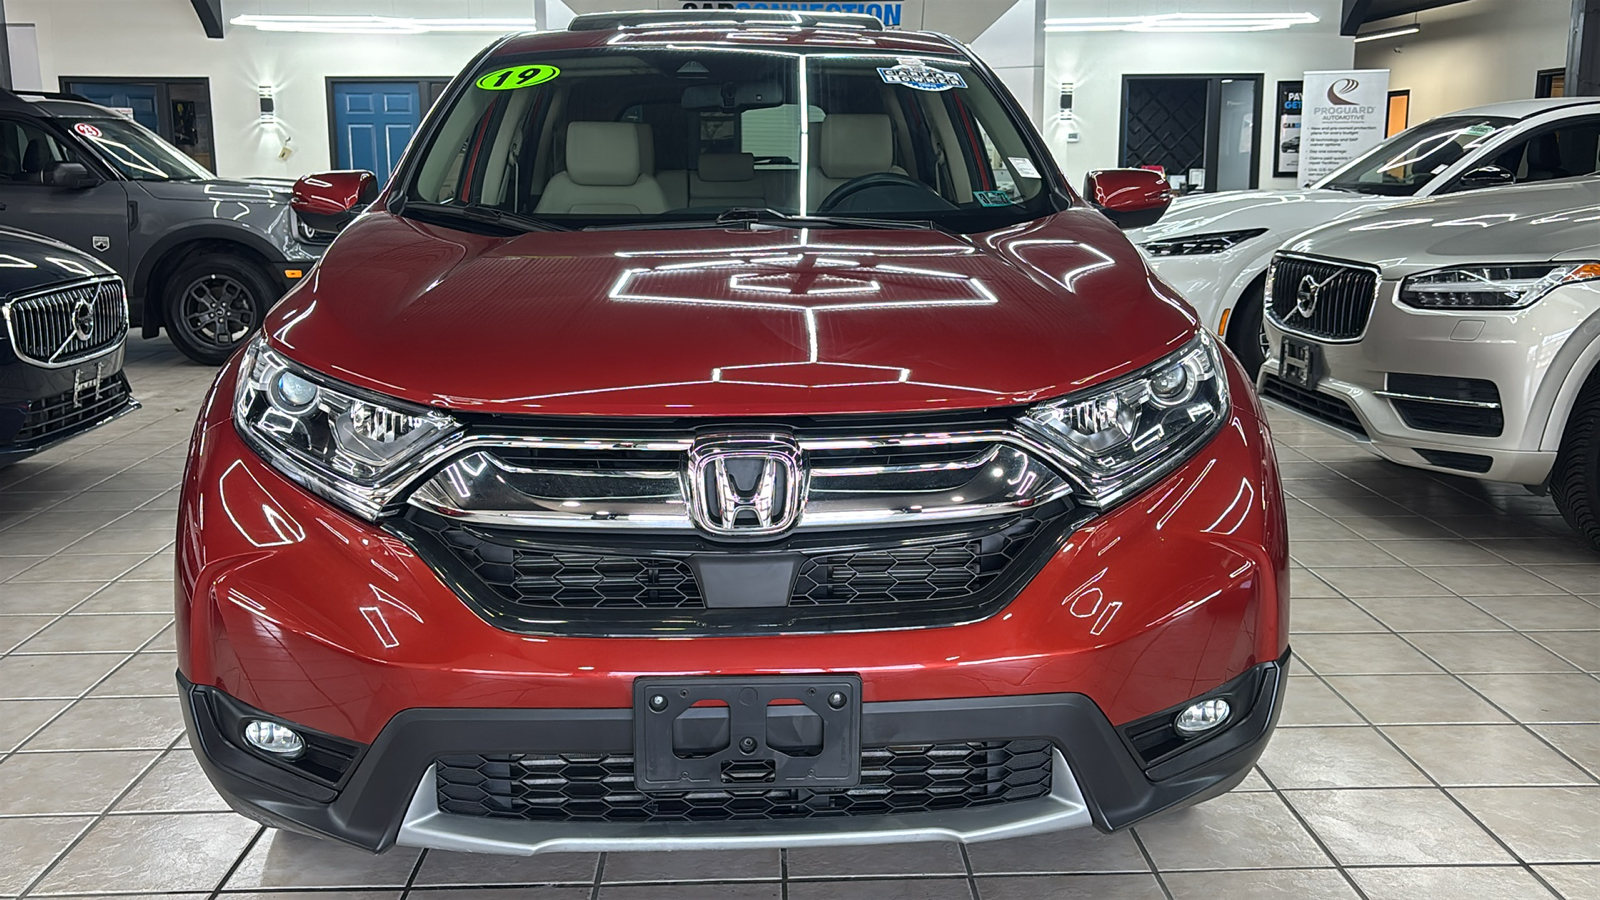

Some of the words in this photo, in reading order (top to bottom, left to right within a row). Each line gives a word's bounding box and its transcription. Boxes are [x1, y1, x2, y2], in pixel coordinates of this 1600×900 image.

[493, 68, 541, 87] 19
[884, 69, 958, 81] CARFAX
[901, 76, 961, 86] OWNER
[1313, 106, 1375, 115] PROGUARD
